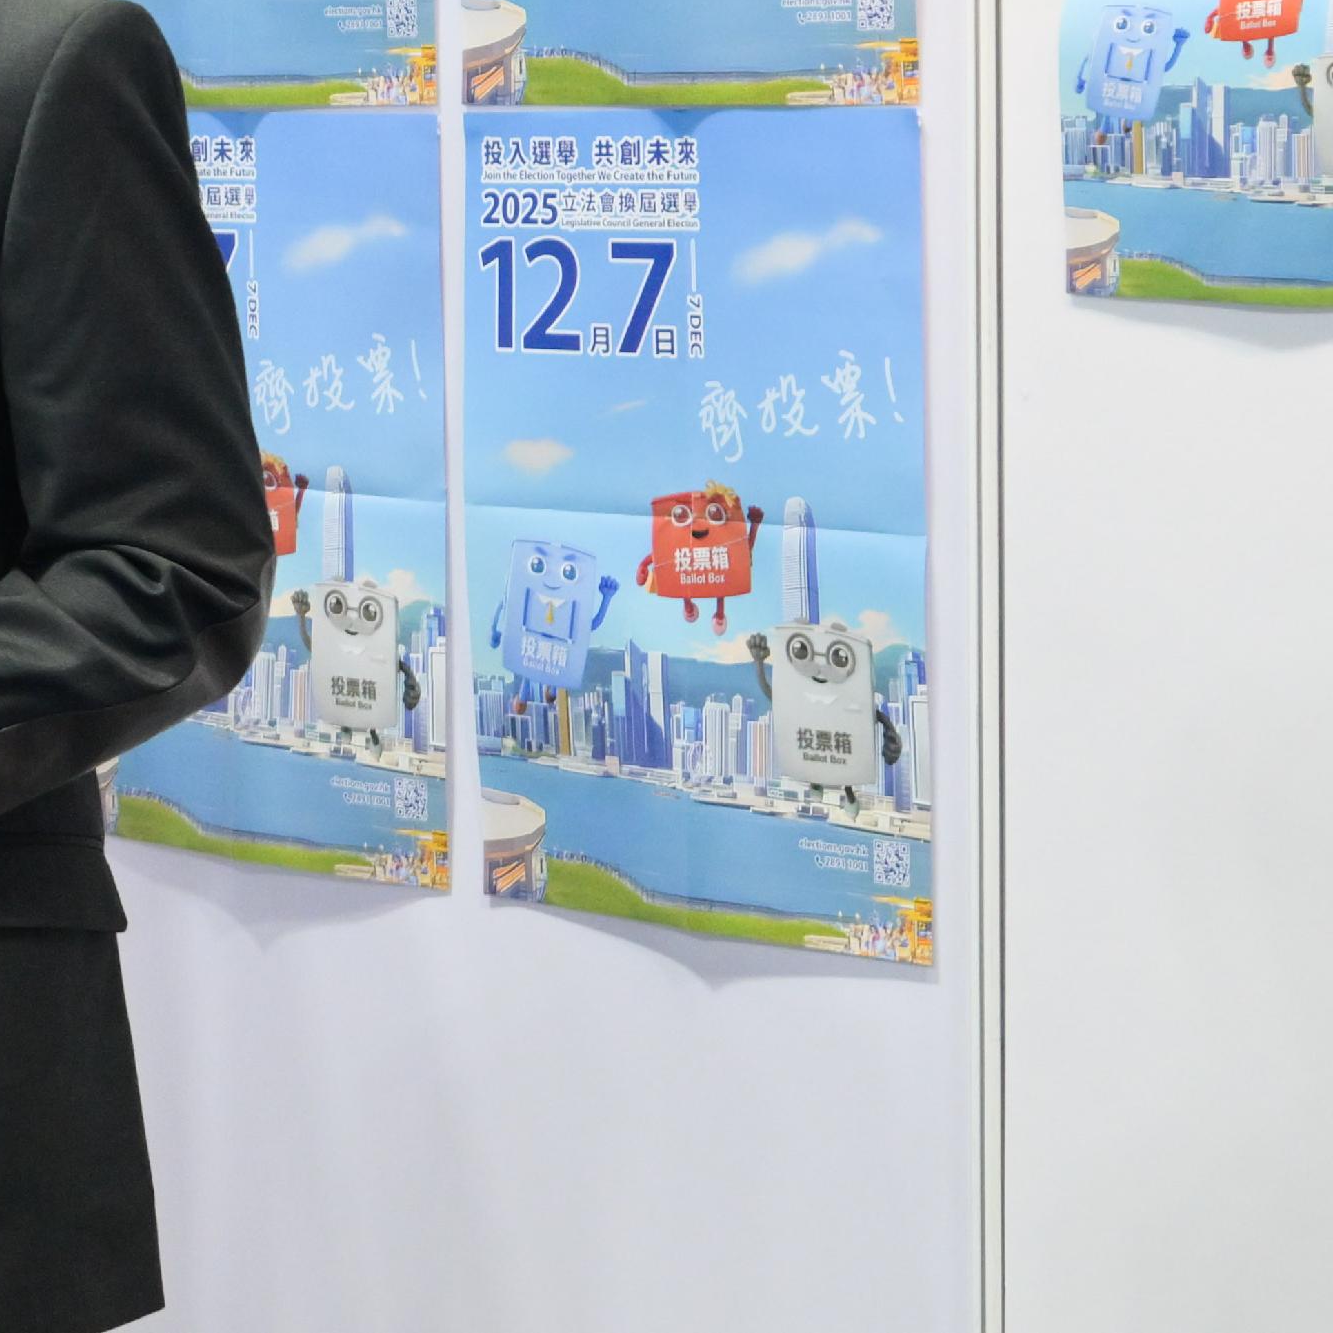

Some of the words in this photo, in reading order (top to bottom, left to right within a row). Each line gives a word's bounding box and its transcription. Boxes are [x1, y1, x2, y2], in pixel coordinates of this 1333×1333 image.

[483, 138, 575, 166] 投入選舉
[594, 138, 697, 166] 共創未來
[483, 171, 501, 180] Join
[504, 171, 517, 180] the
[520, 171, 553, 180] Election
[557, 171, 595, 182] Together
[598, 171, 611, 180] We
[614, 171, 645, 181] Create
[648, 172, 663, 181] the
[666, 170, 697, 182] Future
[689, 314, 702, 356] DEC
[699, 350, 904, 462] 齊投票!
[674, 545, 730, 571] 投票箱
[679, 572, 705, 586] Ballot
[707, 573, 726, 585] Box
[331, 674, 377, 700] 投票箱
[796, 728, 853, 754] 投票箱
[803, 751, 828, 763] Ballot
[829, 754, 848, 765] Box
